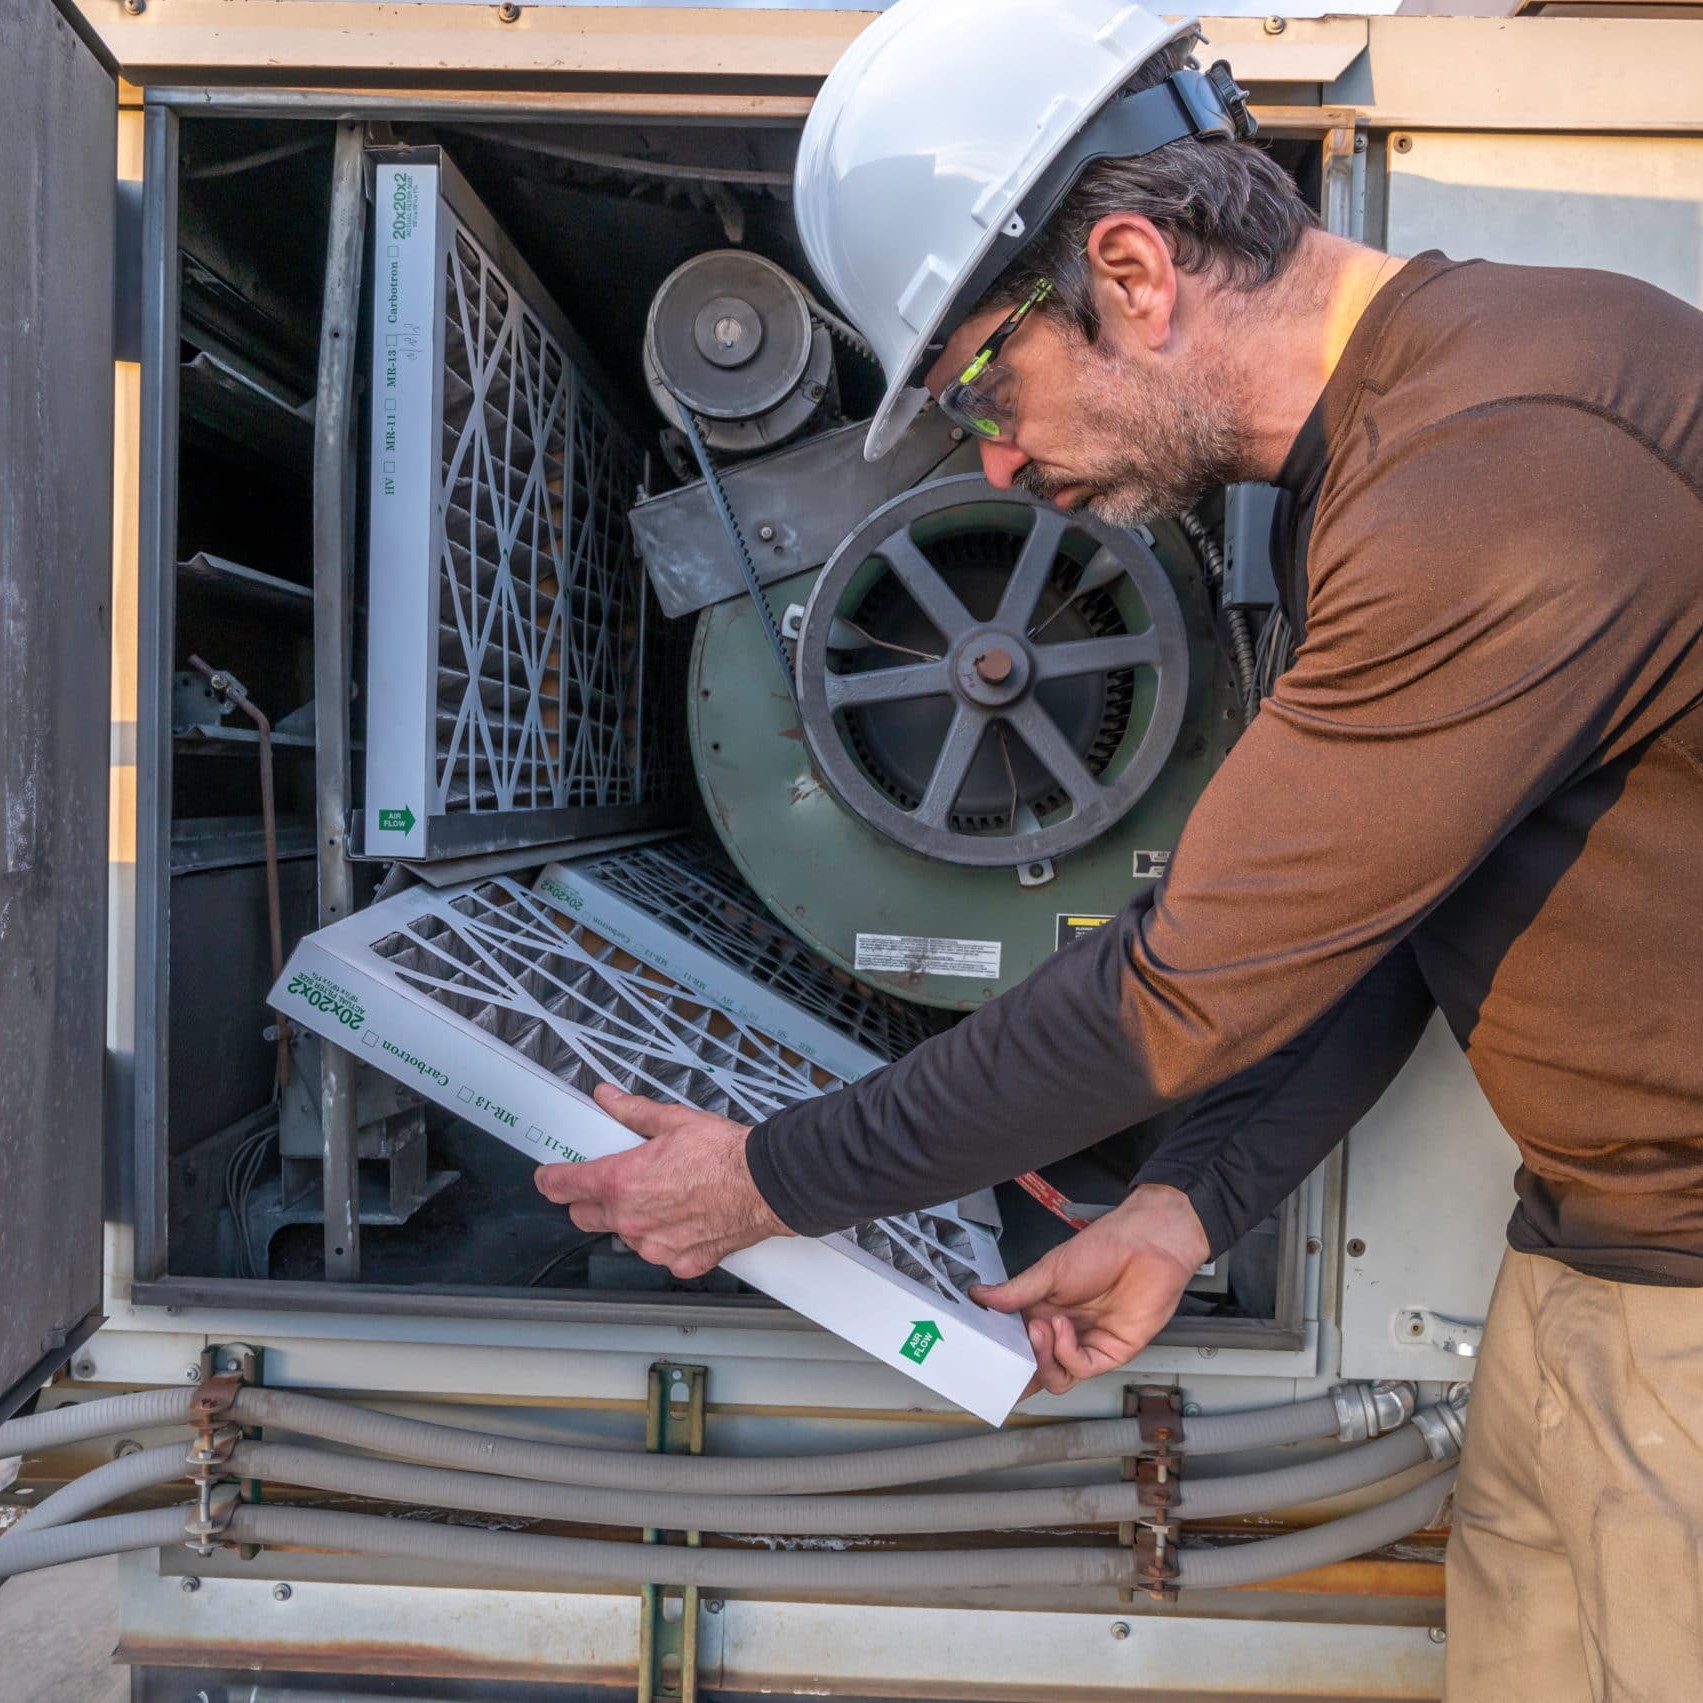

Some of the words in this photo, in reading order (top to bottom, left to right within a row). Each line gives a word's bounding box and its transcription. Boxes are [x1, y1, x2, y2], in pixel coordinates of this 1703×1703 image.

[392, 172, 407, 240] 20x20x2
[387, 261, 399, 324] Carbotron
[386, 350, 397, 387] MR-13
[385, 415, 396, 451] MR-11
[385, 477, 395, 495] HV
[383, 820, 406, 828] FLOW
[388, 812, 402, 820] AIR
[541, 879, 584, 911] 20x20x2
[298, 971, 313, 986] SIZE
[313, 982, 339, 1000] FILTER
[287, 976, 365, 1030] 20x20x2
[339, 995, 366, 1015] ACTUAL
[382, 1040, 449, 1087] Carbotron
[475, 1095, 520, 1128] MR-13
[909, 1332, 923, 1349] AIR
[913, 1331, 933, 1358] FLOW
